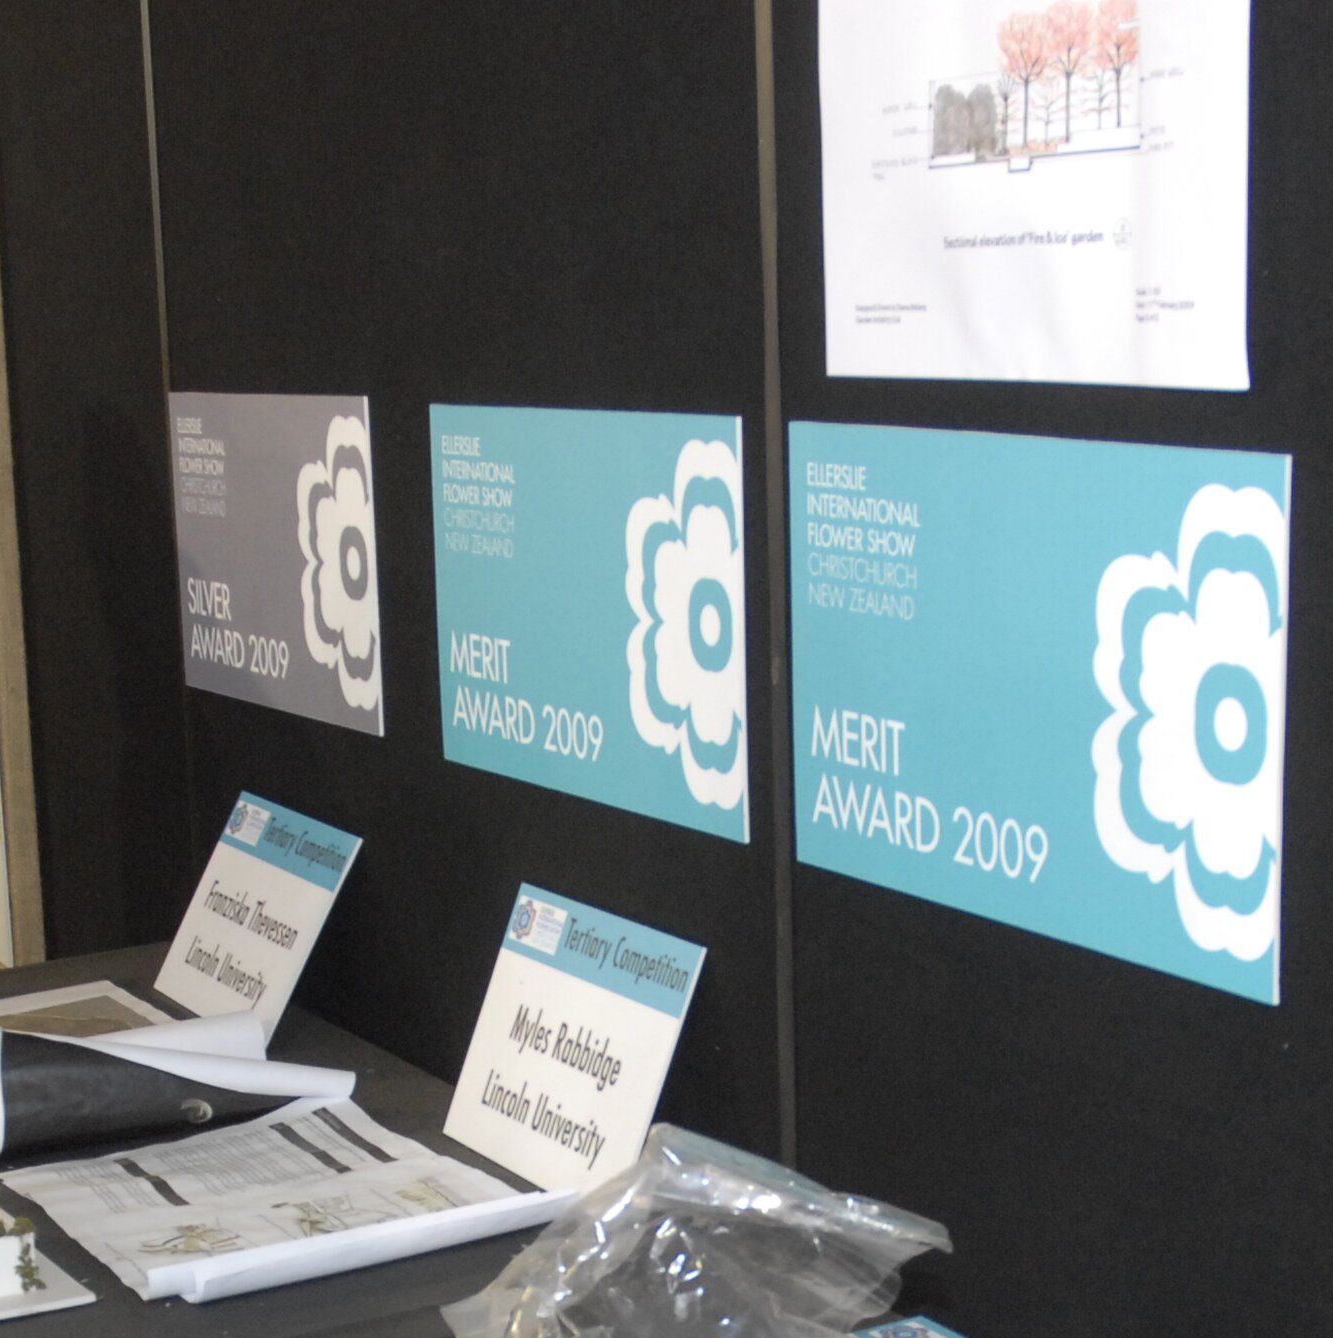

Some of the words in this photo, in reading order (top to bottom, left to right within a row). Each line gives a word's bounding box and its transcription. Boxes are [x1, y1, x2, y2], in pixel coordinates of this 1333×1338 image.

[944, 235, 977, 248] Sectional
[979, 234, 1015, 246] elevation
[1017, 233, 1026, 244] of
[1071, 230, 1104, 246] garden
[178, 438, 225, 456] INTERNATIONAL
[179, 456, 202, 474] FLOWER
[203, 459, 224, 476] SHOW
[442, 460, 515, 484] INTERNATIONAL
[807, 462, 866, 490] ELLERSLIE
[443, 482, 480, 507] FLOWER
[482, 485, 513, 509] SHOW
[807, 493, 920, 527] INTERNATIONAL
[444, 507, 515, 533] CHRISTCHURCH
[807, 523, 865, 552] FLOWER
[866, 528, 915, 557] SHOW
[445, 531, 470, 553] NEW
[471, 534, 514, 559] ZEALAND
[807, 552, 918, 590] CHRISTCHURCH
[187, 577, 232, 622] SILVER
[807, 582, 846, 609] NEW
[849, 587, 915, 620] ZEALAND
[191, 623, 245, 670] AWARD
[249, 634, 289, 679] 2009
[450, 630, 511, 685] MERIT
[453, 685, 536, 746] AWARD
[541, 703, 603, 762] 2009
[811, 704, 905, 777] MERIT
[263, 817, 297, 857] Tertiary
[295, 830, 347, 873] Competition
[812, 773, 941, 853] AWARD
[953, 806, 1049, 884] 2009
[204, 880, 250, 926] Franziska
[248, 900, 298, 950] Thevessen
[185, 935, 220, 978] Lincoln
[217, 952, 267, 1010] University
[563, 917, 612, 970] Tertiary
[612, 936, 689, 994] Competition
[509, 1004, 552, 1054] Myles
[552, 1022, 621, 1092] Rabbidge
[481, 1069, 529, 1125] Lincoln
[531, 1093, 606, 1170] University
